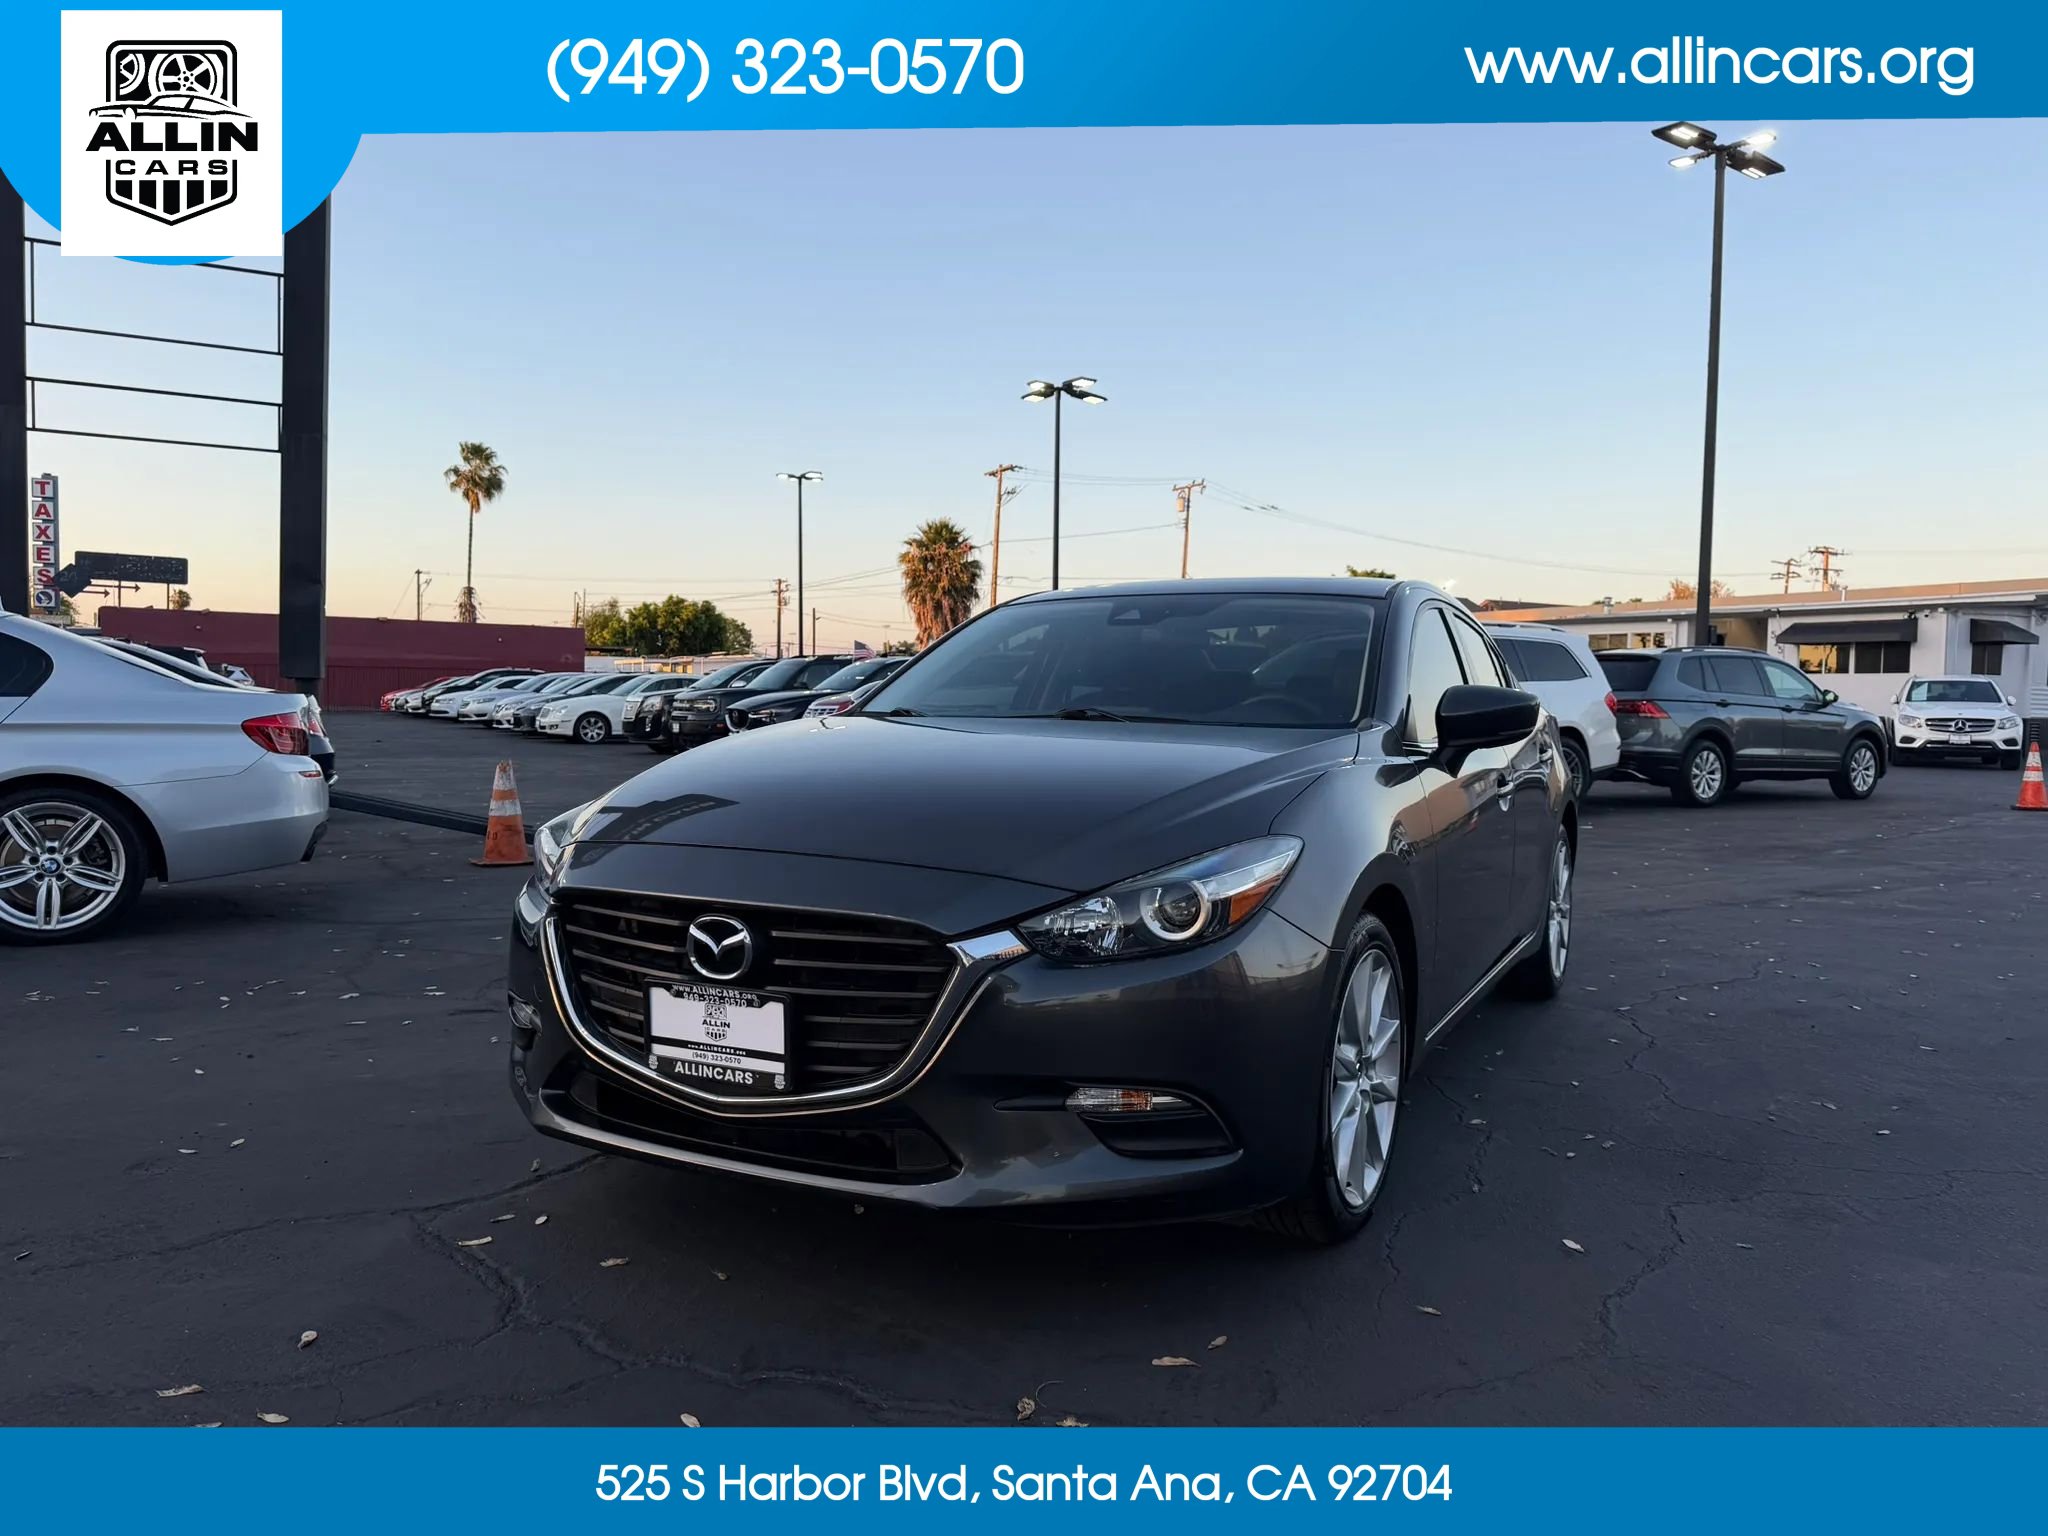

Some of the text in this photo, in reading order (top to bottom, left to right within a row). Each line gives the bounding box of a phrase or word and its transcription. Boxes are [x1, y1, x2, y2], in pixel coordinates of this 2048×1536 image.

[34, 480, 54, 584] TAXES
[684, 992, 747, 1008] 949-323-0570
[702, 1019, 730, 1029] ALLIN
[692, 1051, 742, 1064] (949) 323-0570
[675, 1061, 753, 1084] ALLINCARS
